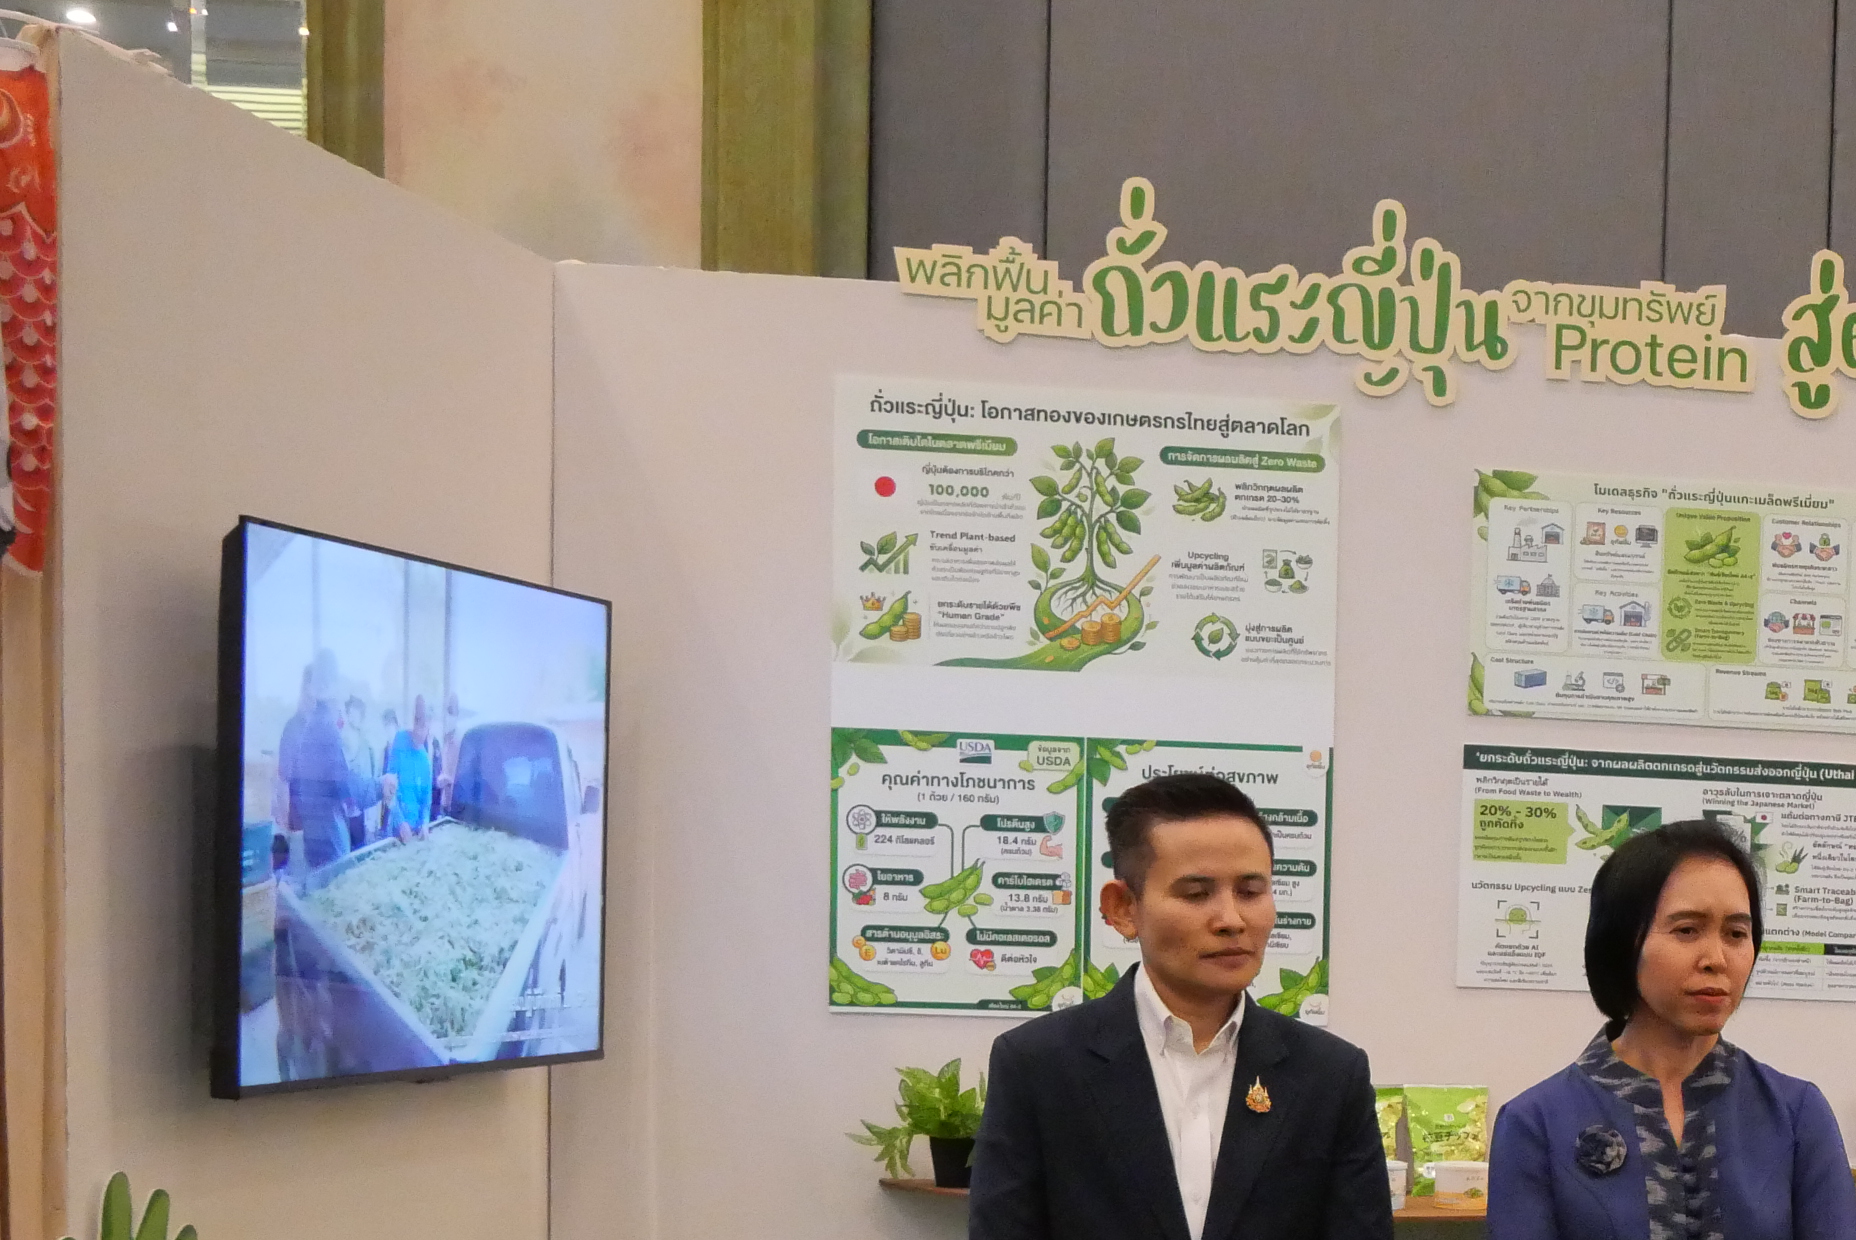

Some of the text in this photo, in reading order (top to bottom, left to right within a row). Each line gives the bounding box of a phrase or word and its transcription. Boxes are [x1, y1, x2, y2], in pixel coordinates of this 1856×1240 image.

[905, 246, 1052, 296] พลิกฟื้น
[1092, 185, 1508, 399] ถั่วแระญี่ปุ่น
[985, 288, 1086, 332] มูลค่า
[1511, 288, 1718, 330] จากขุมทรัพย์
[1553, 323, 1749, 384] Protein
[870, 388, 1310, 438] ถั่วแระญี่ปุ่น: โอกาสทองของเกษตรกรไทยสู่ตลาดโลก
[1261, 457, 1284, 467] Zero
[1287, 459, 1317, 469] Waste
[928, 484, 989, 499] 100,000
[1594, 483, 1658, 502] โมเดลธุรกิจ
[930, 530, 1016, 542] Trend Plant-based
[1188, 551, 1229, 562] Upcycling
[959, 741, 992, 752] USDA
[1036, 756, 1071, 768] USDA
[881, 769, 1036, 792] คุณค่าทางโภชนาการ
[1819, 768, 1855, 782] (Uthai
[957, 794, 976, 803] 160
[1475, 786, 1497, 796] (From
[1498, 787, 1517, 796] Food
[1518, 788, 1542, 797] Waste
[1552, 790, 1582, 799] Wealth)
[1479, 804, 1557, 819] 20% 30%
[874, 834, 893, 844] 224
[997, 835, 1018, 846] 18.4
[1471, 880, 1512, 892] นวัตกรรม
[1514, 883, 1556, 894] Upcycling
[1794, 886, 1820, 896] Smart
